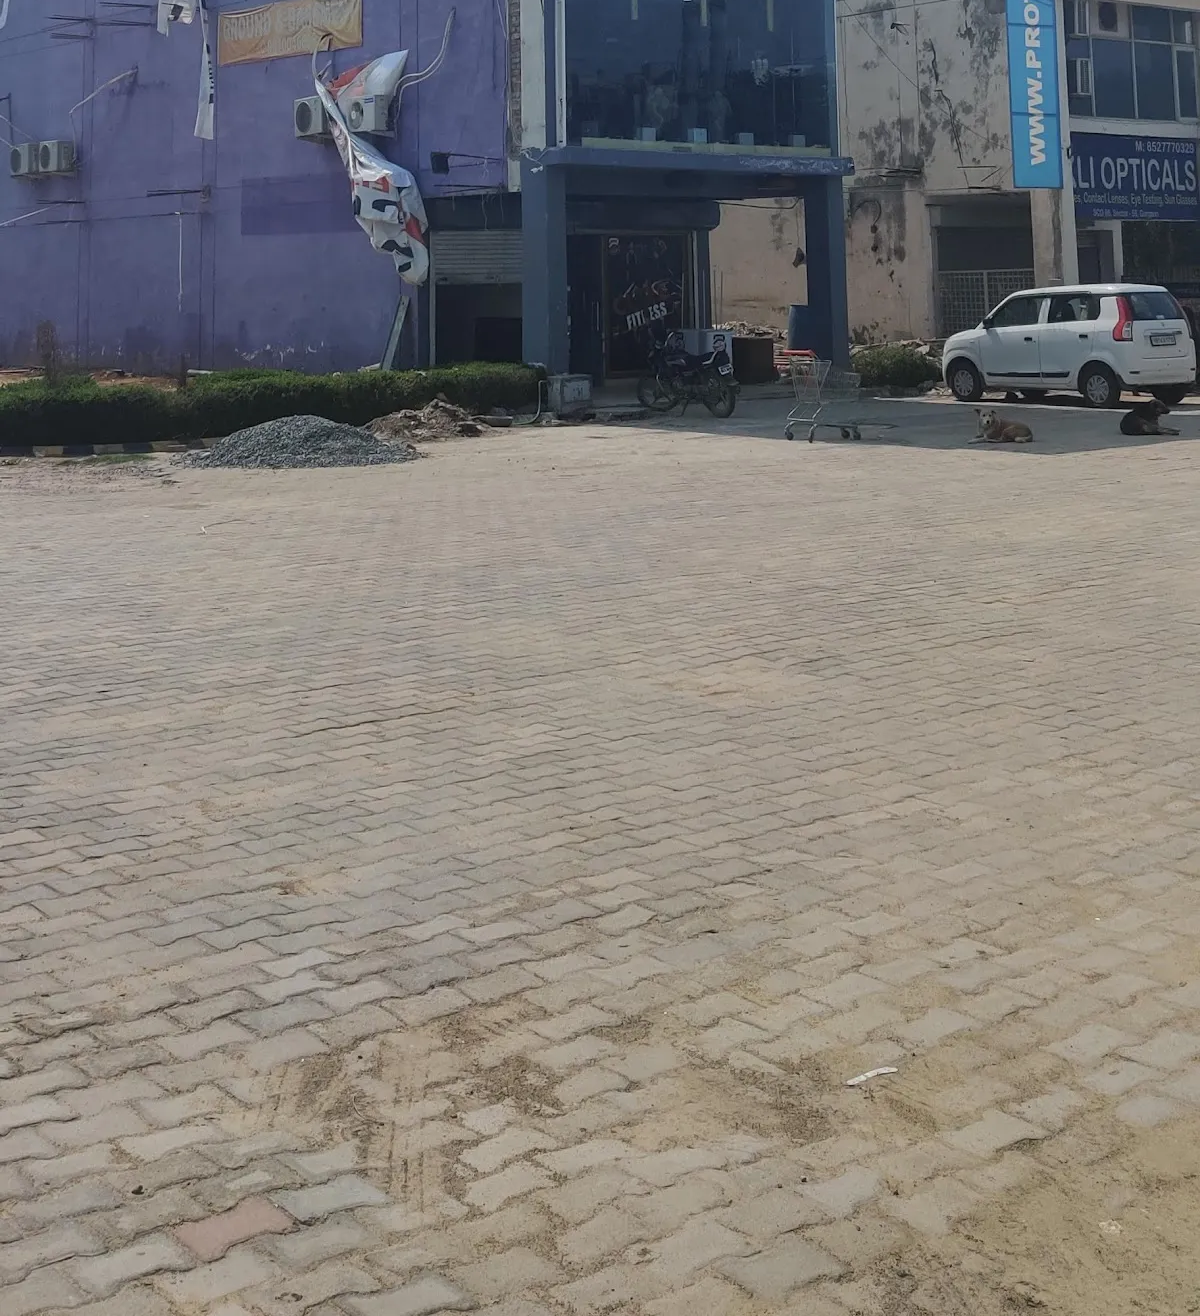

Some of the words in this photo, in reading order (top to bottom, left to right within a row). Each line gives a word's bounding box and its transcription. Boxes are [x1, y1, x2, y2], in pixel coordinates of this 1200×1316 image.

[1135, 141, 1145, 153] M:
[1146, 141, 1195, 154] 8527770329
[1100, 156, 1197, 192] OPTICALS
[1083, 191, 1107, 204] Contact
[1130, 192, 1141, 207] Eye
[1164, 194, 1176, 205] Sun
